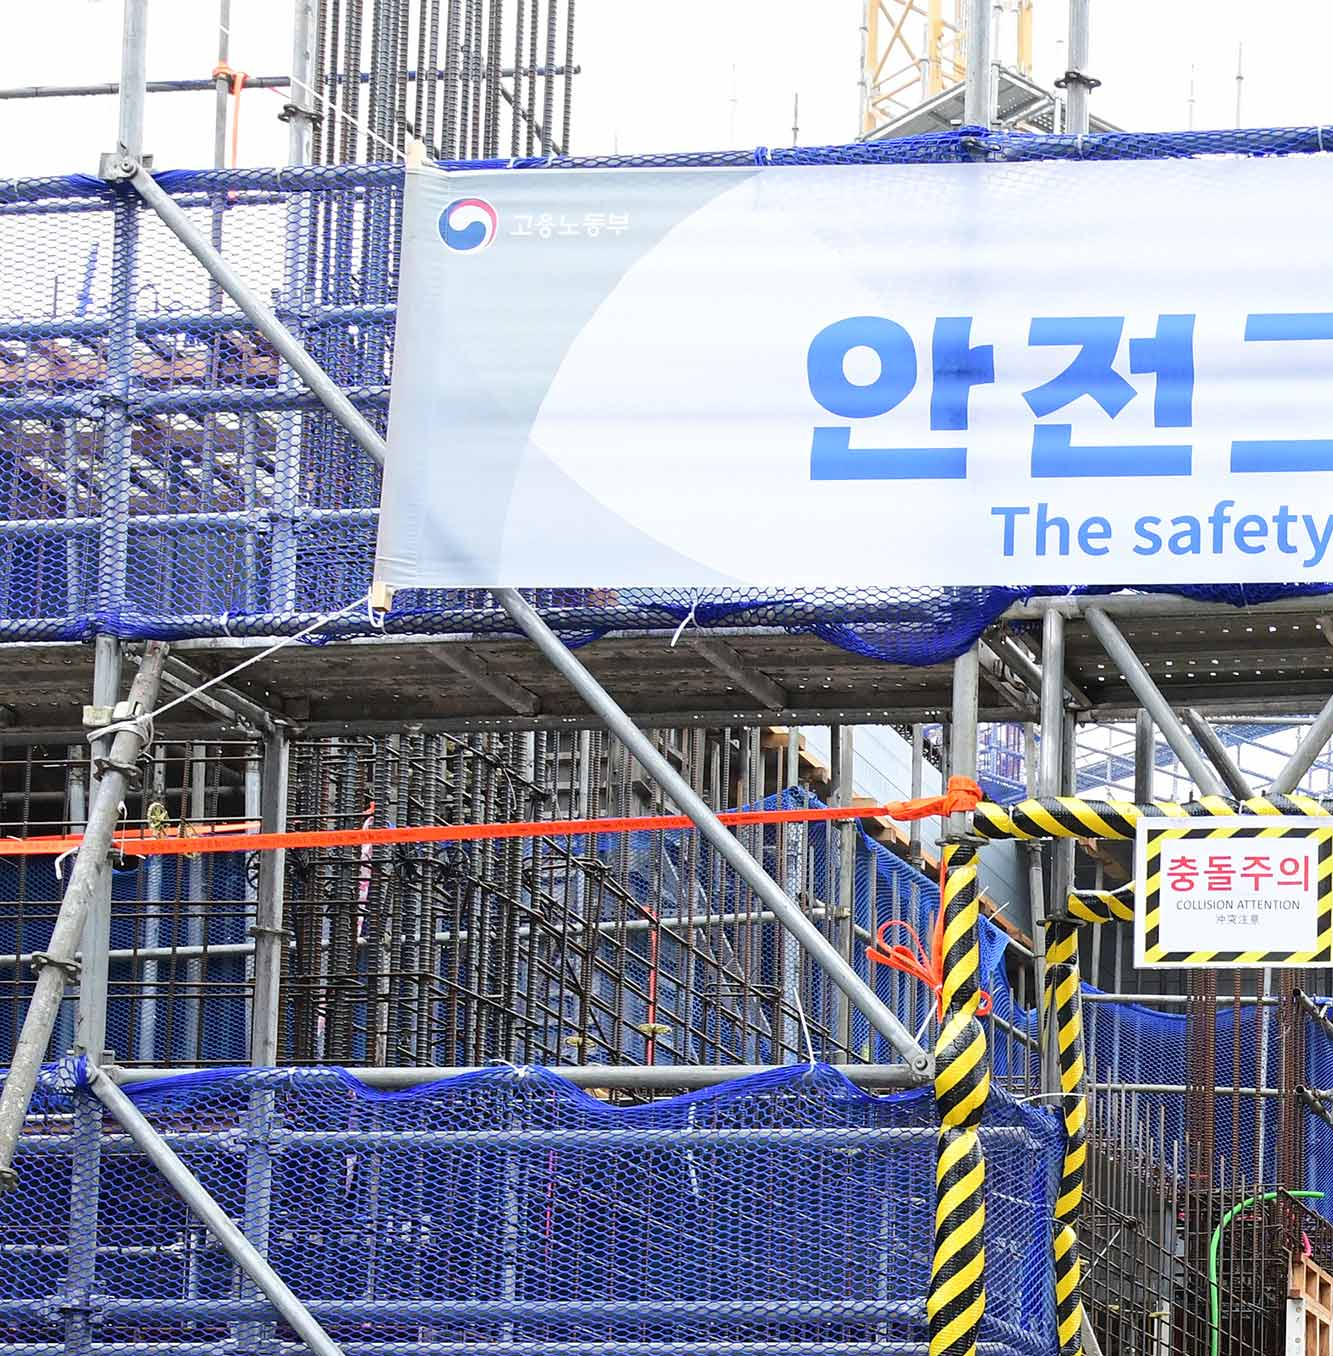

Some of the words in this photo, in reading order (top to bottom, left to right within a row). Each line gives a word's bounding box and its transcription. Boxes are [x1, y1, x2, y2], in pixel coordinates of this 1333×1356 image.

[509, 213, 631, 239] 고용노동부
[991, 502, 1113, 557] The
[1167, 855, 1310, 892] 충돌주의
[1176, 899, 1233, 911] COLLISION
[1236, 899, 1300, 910] ATTENTION
